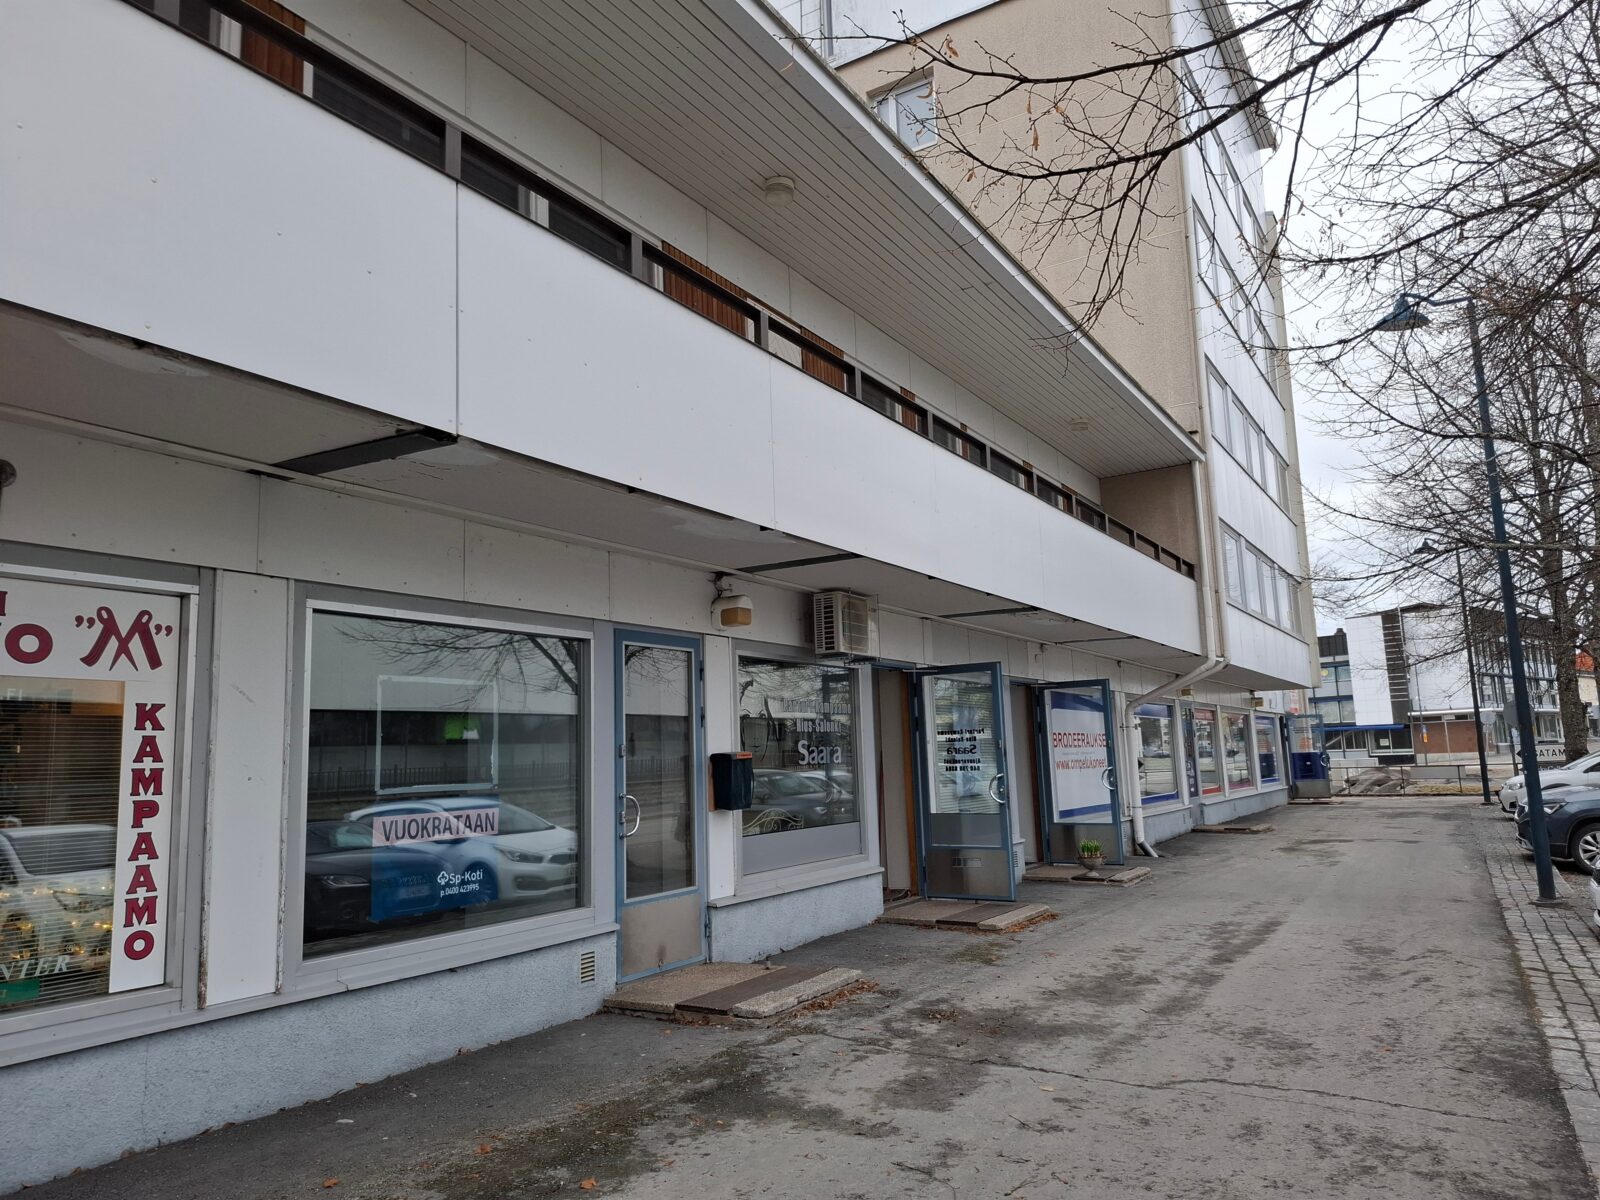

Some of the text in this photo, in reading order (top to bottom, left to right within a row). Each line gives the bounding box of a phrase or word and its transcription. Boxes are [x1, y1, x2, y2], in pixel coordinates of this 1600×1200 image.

[797, 740, 842, 765] Saara
[123, 702, 166, 961] KAMPAAMO
[381, 812, 495, 842] VUOKRATAAN
[449, 869, 483, 885] Sp-Koti
